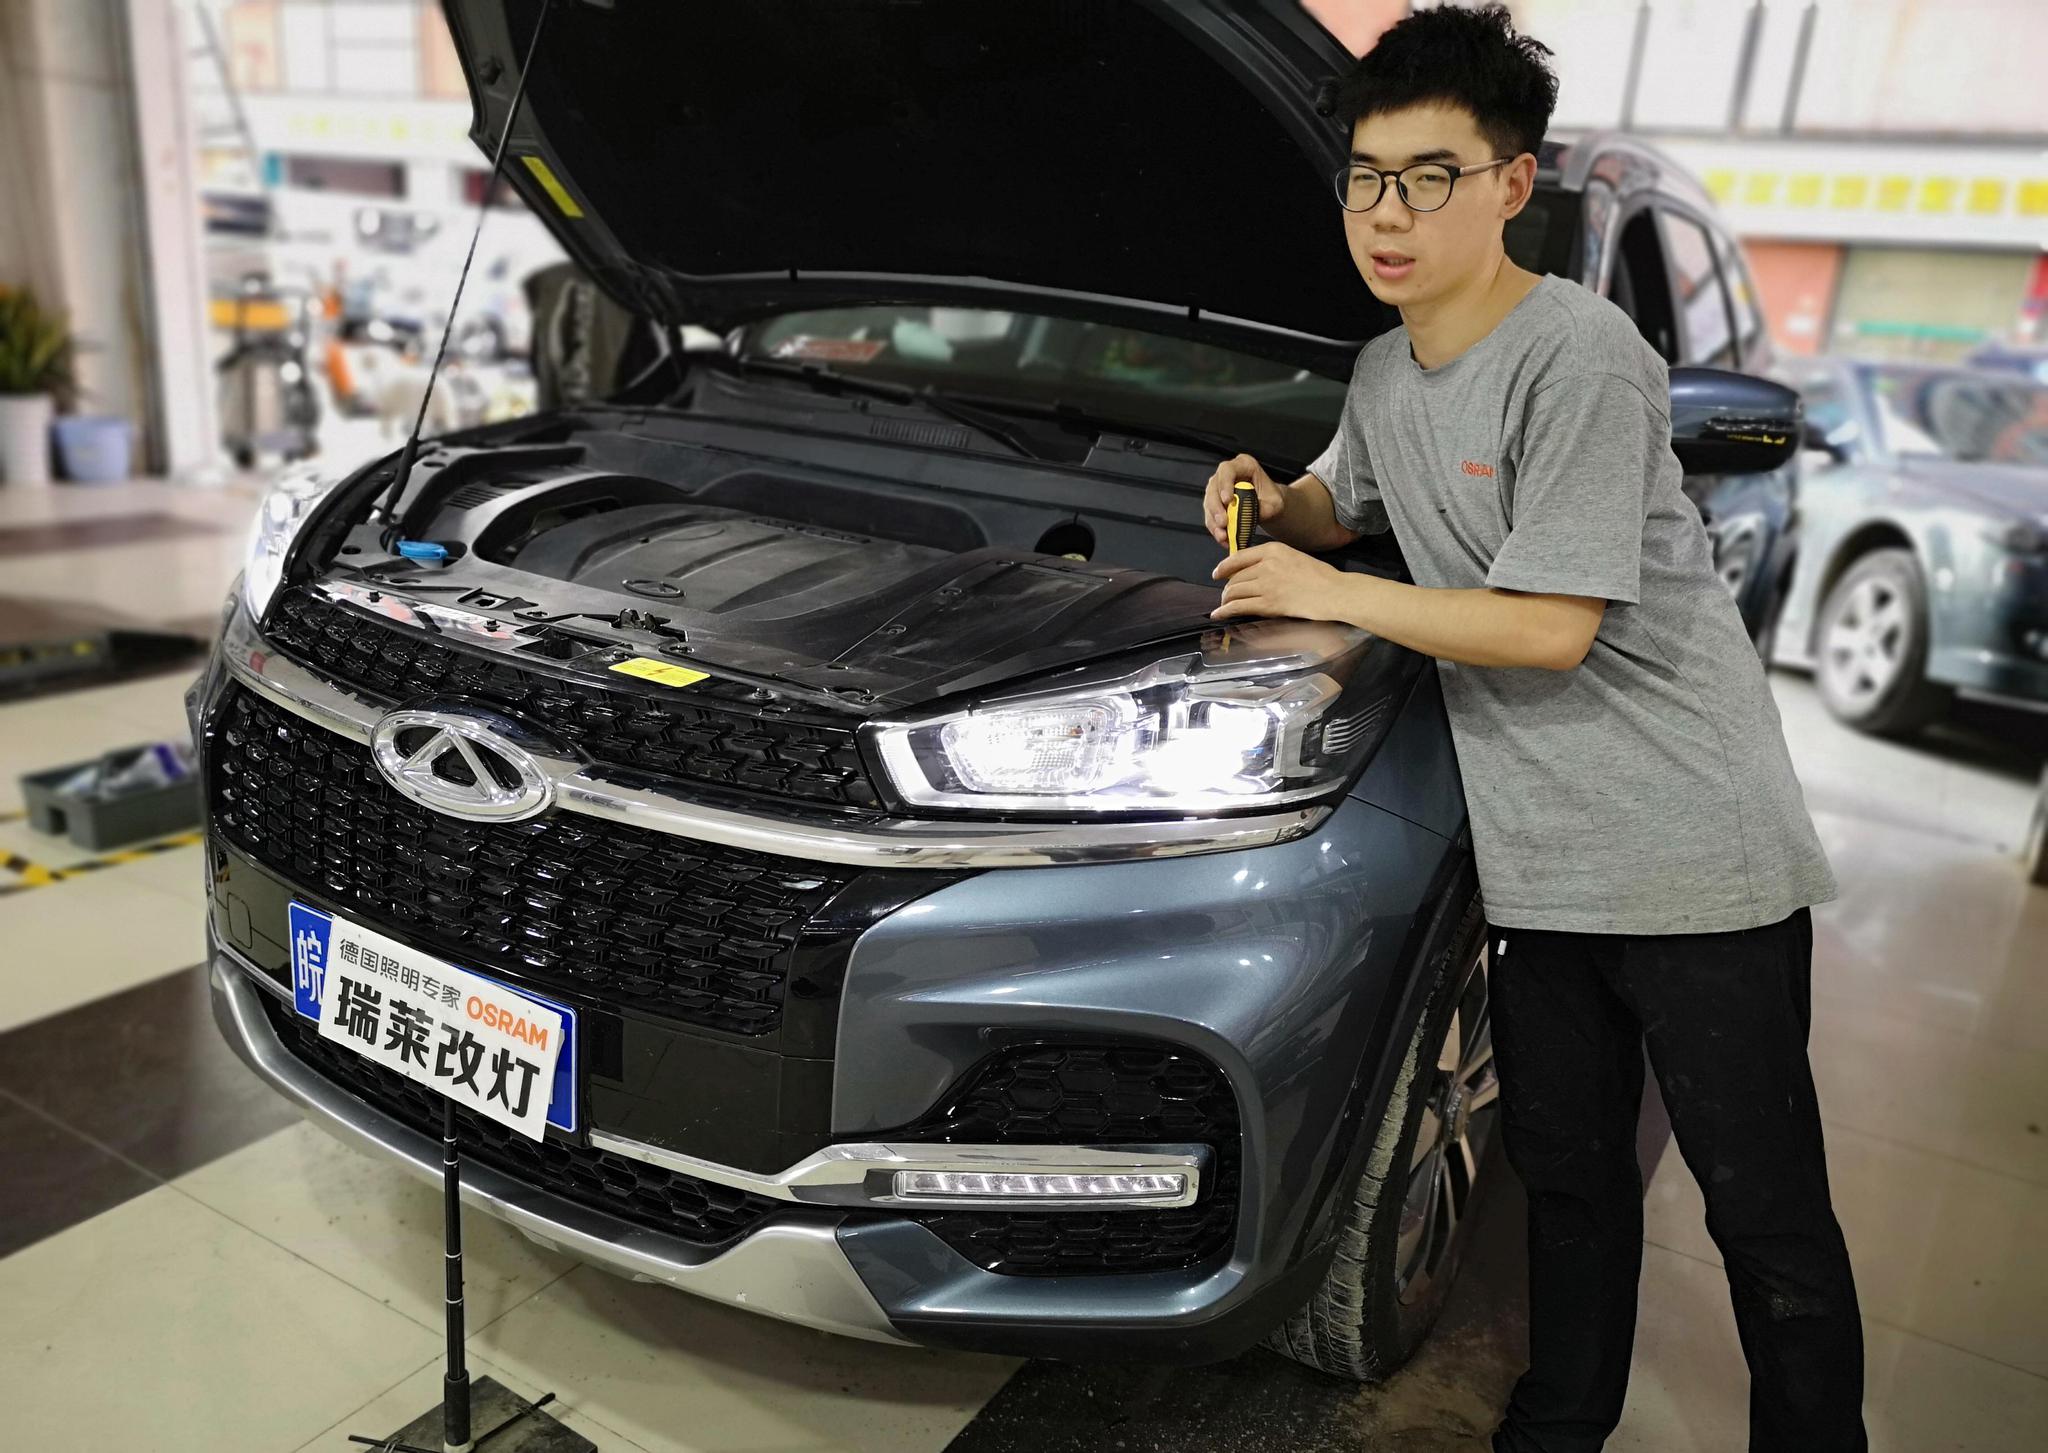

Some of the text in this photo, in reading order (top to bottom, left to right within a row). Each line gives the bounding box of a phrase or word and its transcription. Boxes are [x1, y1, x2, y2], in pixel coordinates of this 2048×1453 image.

[297, 929, 324, 1005] 皖
[340, 938, 549, 1052] 德国照明专家 OSRAM
[333, 976, 540, 1119] 瑞莱改灯
